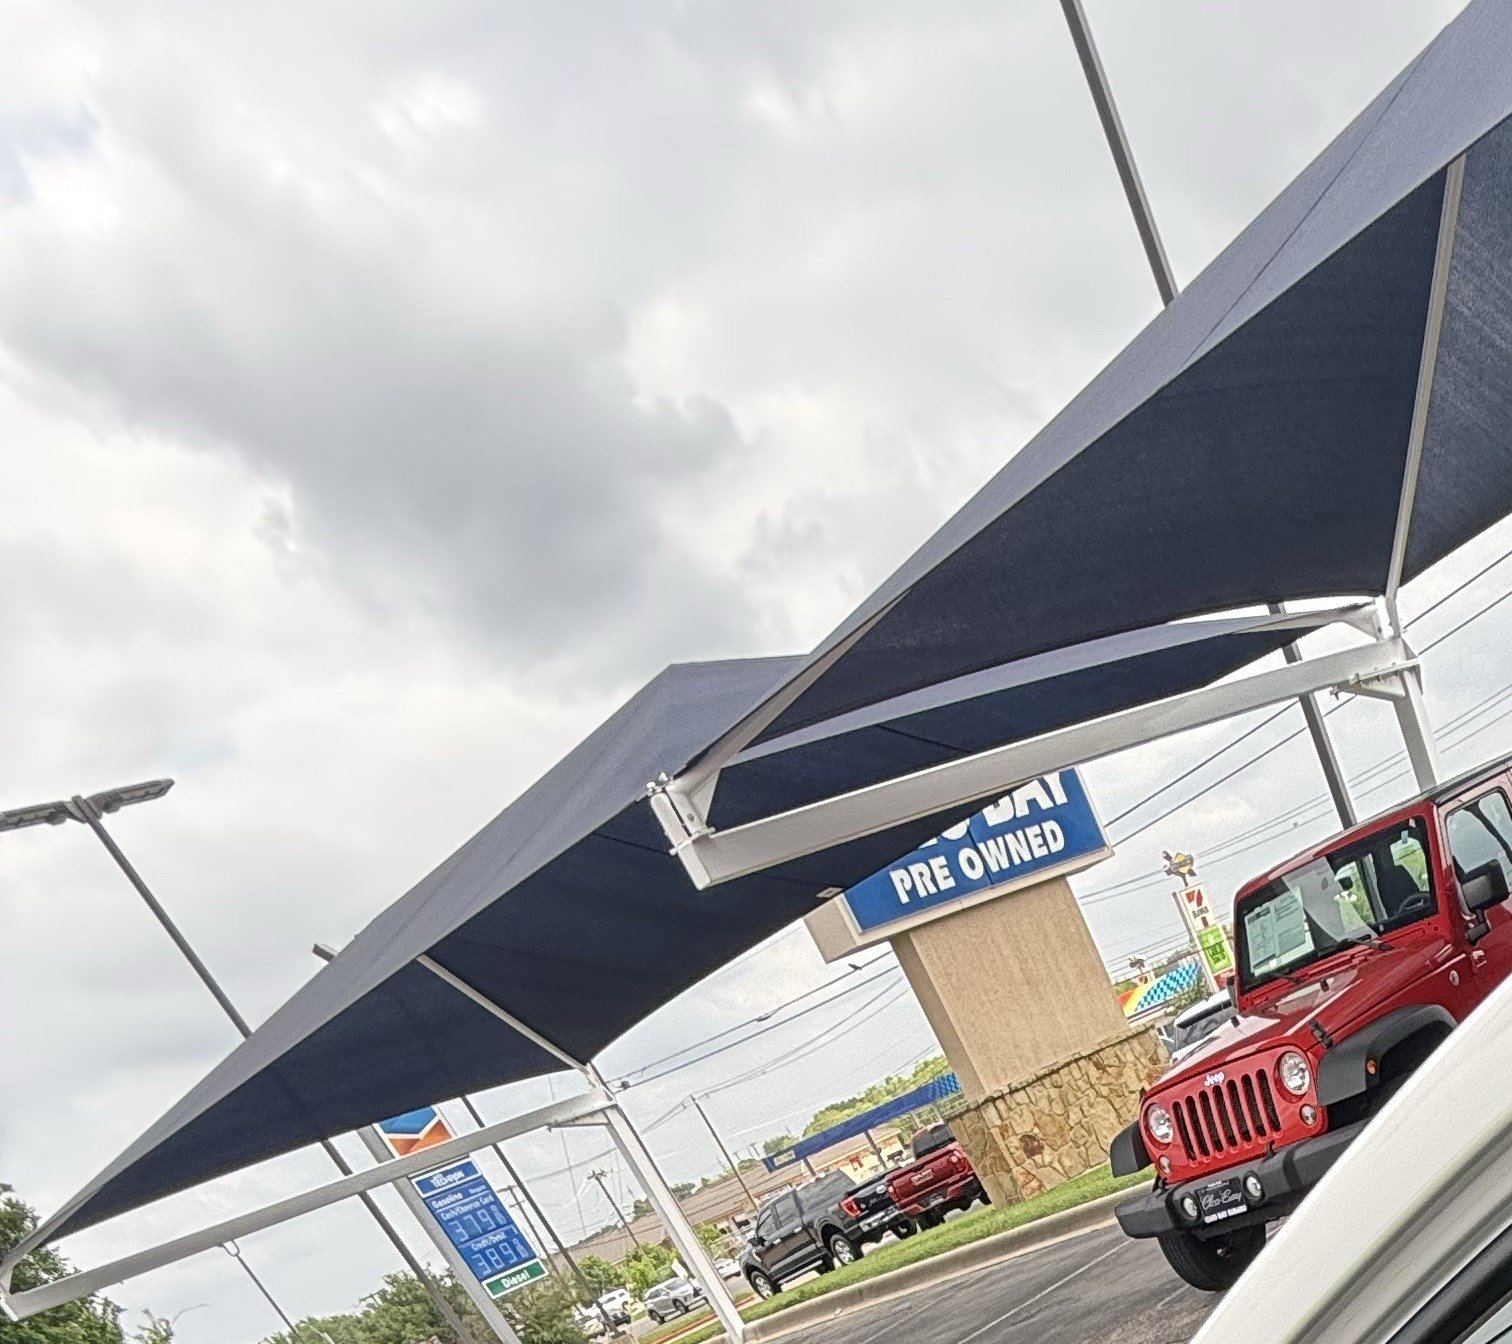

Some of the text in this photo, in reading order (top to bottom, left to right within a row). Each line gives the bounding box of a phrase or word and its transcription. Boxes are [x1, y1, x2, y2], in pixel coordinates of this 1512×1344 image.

[889, 856, 956, 904] PRE
[957, 819, 1065, 881] OWNED
[1204, 1071, 1225, 1087] Jeep
[500, 1269, 531, 1289] Diesel
